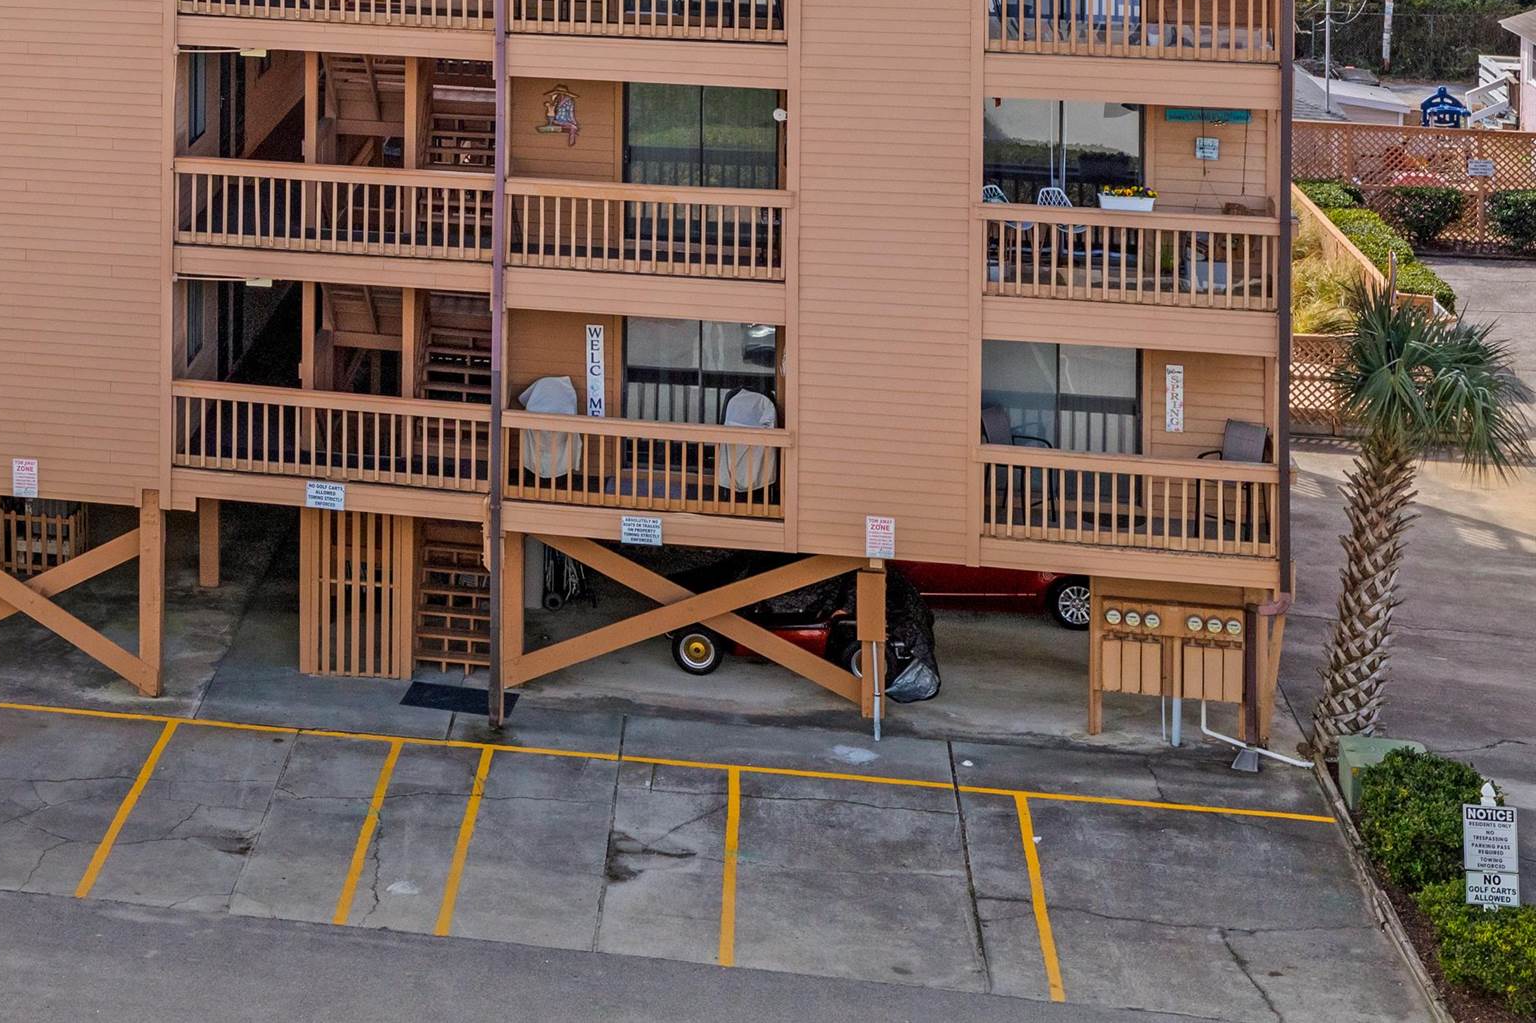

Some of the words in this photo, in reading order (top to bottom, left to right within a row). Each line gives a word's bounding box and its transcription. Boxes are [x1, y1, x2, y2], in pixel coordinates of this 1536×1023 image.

[1170, 376, 1180, 426] SPRING
[1467, 808, 1513, 822] NOTICE
[1484, 874, 1501, 885] NO
[1468, 885, 1489, 893] GOLF
[1490, 887, 1517, 896] CARTS
[1474, 894, 1511, 903] ALLOWED
